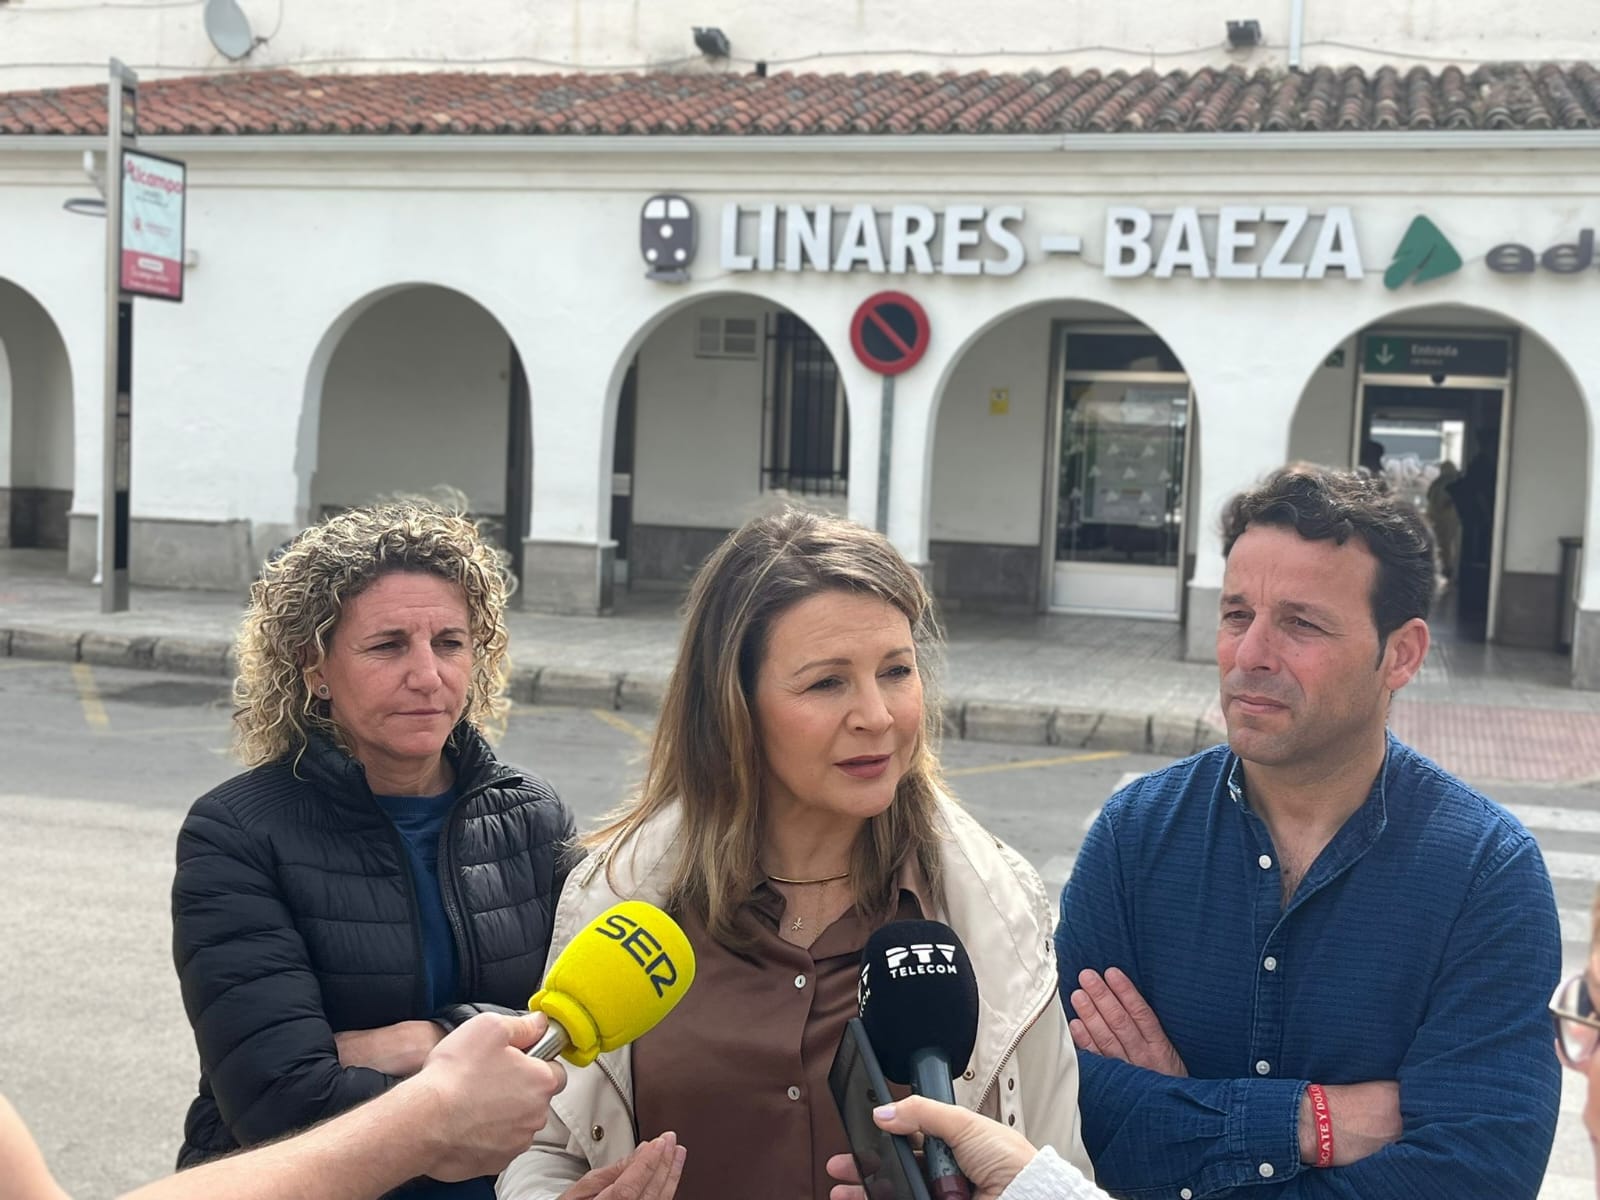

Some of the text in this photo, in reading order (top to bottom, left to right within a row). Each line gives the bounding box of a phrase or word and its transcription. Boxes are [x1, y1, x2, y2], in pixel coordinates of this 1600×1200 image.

[720, 203, 1025, 276] LINARES
[1104, 206, 1364, 279] BAEZA
[1485, 228, 1600, 274] ad
[1411, 343, 1459, 357] Entrada
[595, 914, 677, 998] SER
[889, 964, 958, 979] TELECOM
